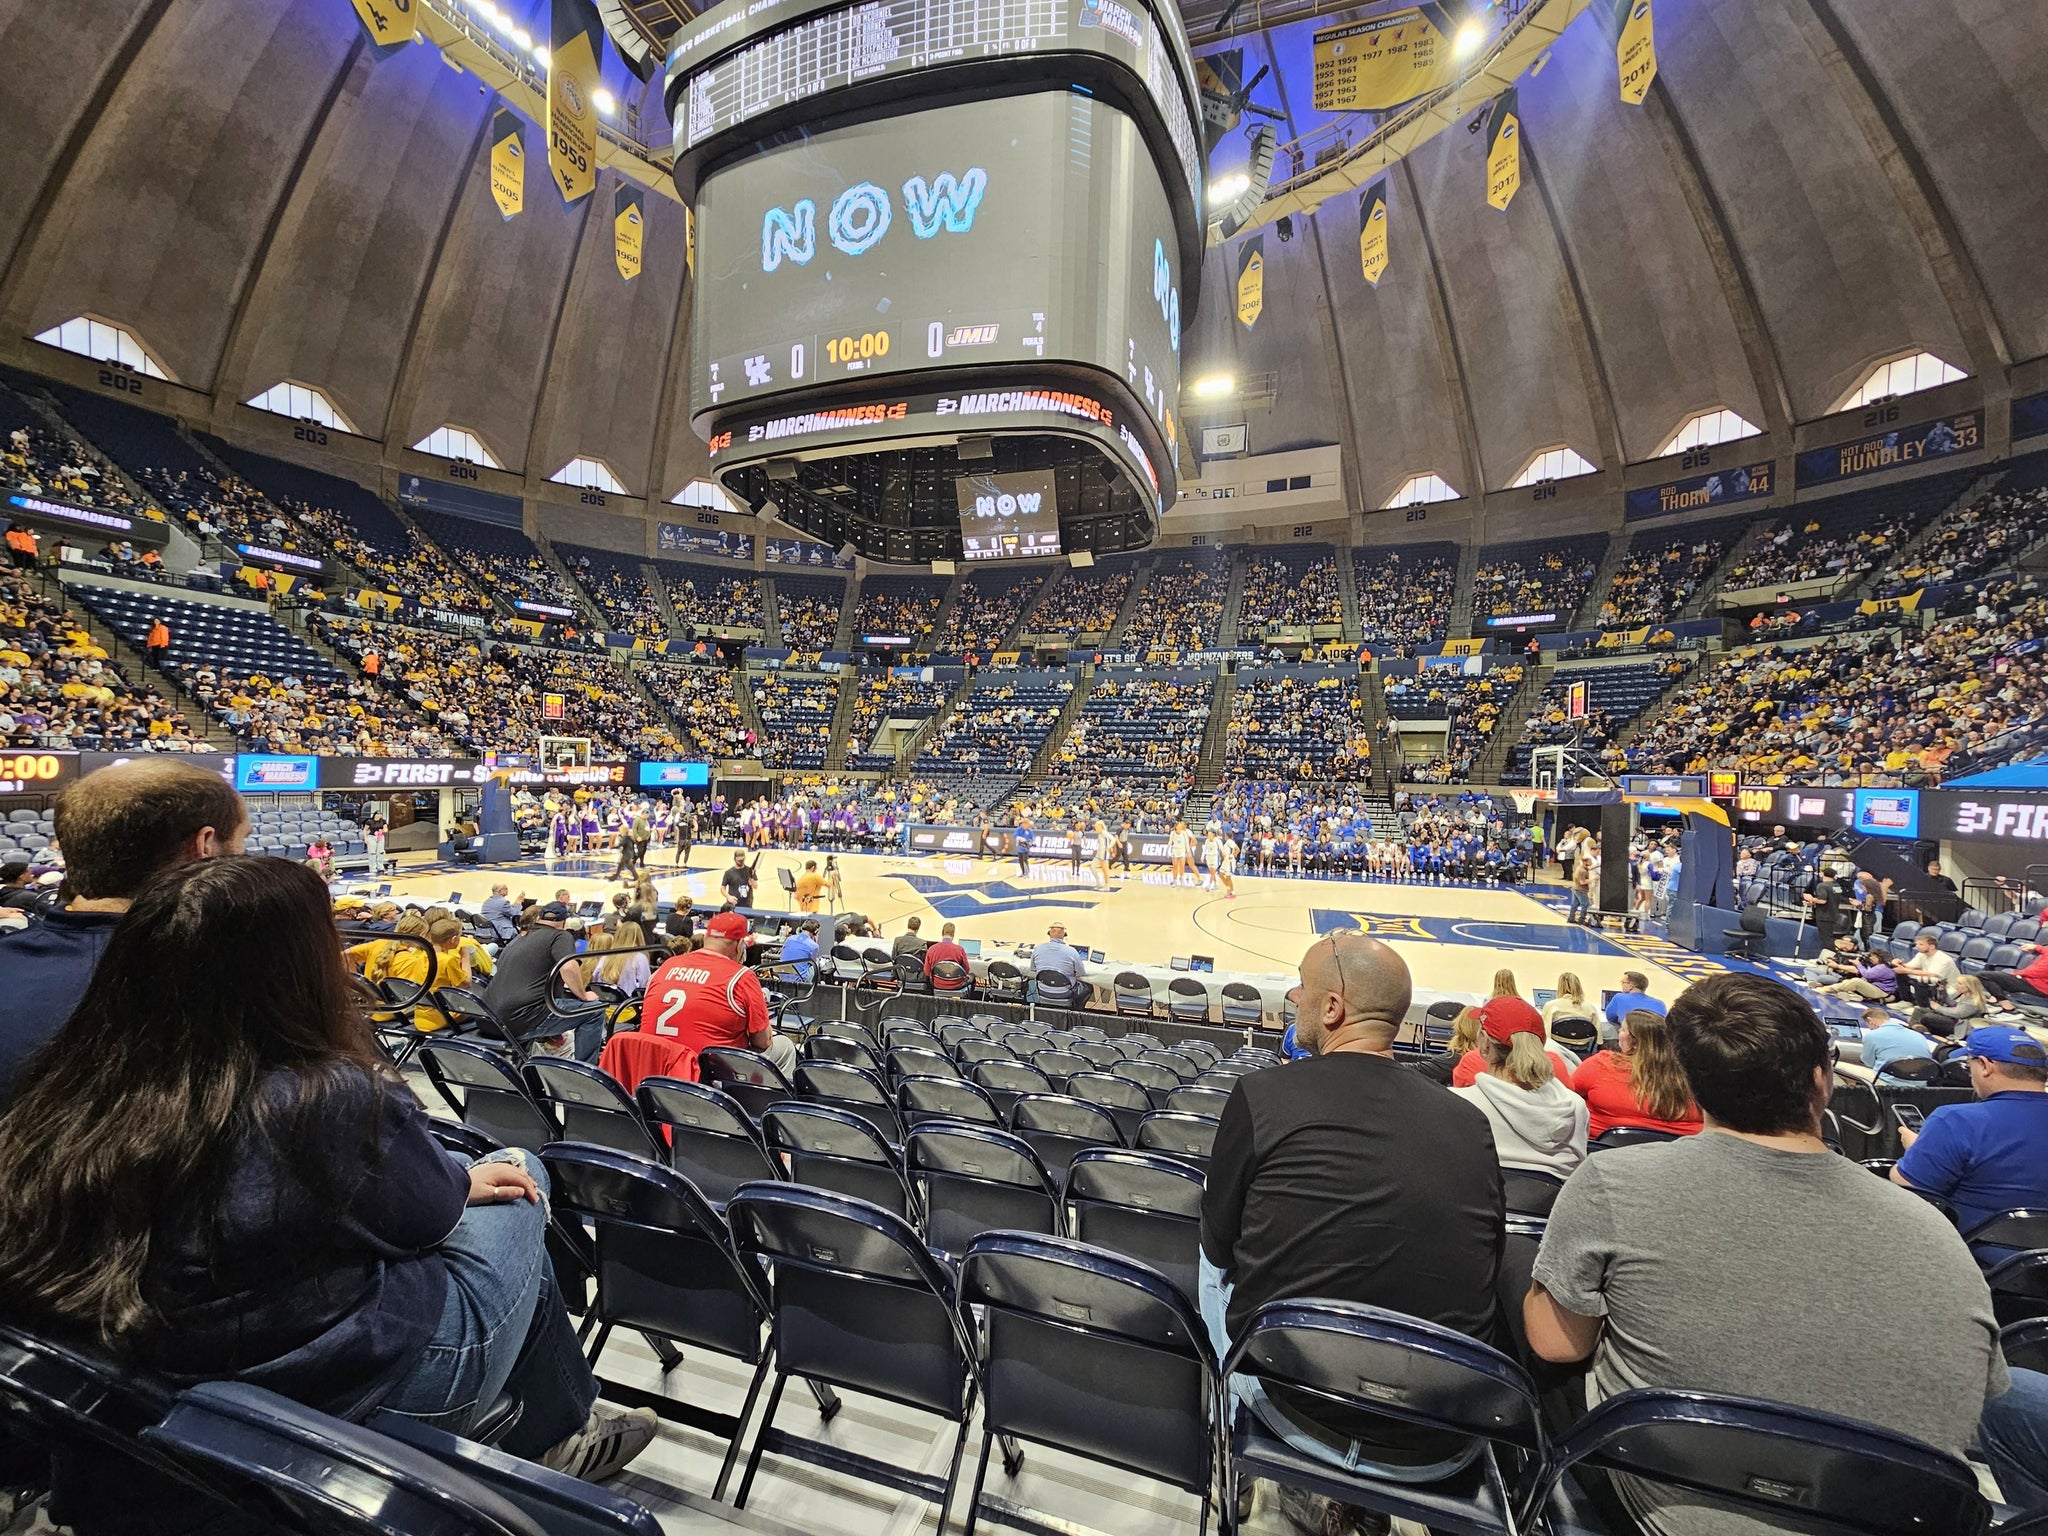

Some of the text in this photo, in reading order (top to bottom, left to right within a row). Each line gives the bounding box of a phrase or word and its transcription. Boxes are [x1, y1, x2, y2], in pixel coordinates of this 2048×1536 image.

[1097, 0, 1132, 23] MARCH
[1101, 12, 1142, 48] MADNESS
[1316, 13, 1421, 43] REGULAR SEASON CHAMPIONS
[1021, 39, 1029, 49] OF
[1316, 38, 1435, 70] 1952 1959 1977 1982 1983
[1315, 48, 1434, 80] 1955 1961 1985
[1315, 59, 1434, 90] 1956 1962 1989
[1314, 95, 1356, 109] 1958 1967
[1315, 86, 1357, 100] 1957 1963
[552, 131, 587, 173] 1959
[494, 179, 519, 202] 2005
[1492, 172, 1515, 195] 2017
[761, 167, 988, 273] NOW
[616, 249, 639, 265] 1960
[946, 324, 999, 346] JMU
[1036, 321, 1042, 333] 4
[826, 331, 890, 363] 10:00
[928, 321, 943, 358] 0
[1036, 345, 1043, 356] 0
[791, 343, 804, 379] 0
[100, 369, 143, 396] 202
[959, 391, 1101, 420] MARCHMADNESS
[1864, 406, 1900, 427] 216
[294, 427, 328, 446] 203
[1956, 427, 1978, 449] 33
[1840, 439, 1884, 458] HOT ROD
[1840, 440, 1926, 475] HUNDLEY
[1682, 451, 1710, 471] 215
[450, 465, 478, 481] 204
[1533, 485, 1556, 500] 214
[1660, 486, 1677, 498] ROD
[1748, 475, 1769, 494] 44
[581, 492, 605, 507] 205
[976, 492, 1041, 517] NOW
[1660, 489, 1711, 512] THORN
[697, 512, 719, 525] 206
[1406, 510, 1426, 522] 213
[1191, 535, 1206, 545] 211
[1293, 525, 1313, 537] 212
[1124, 653, 1136, 663] GO
[1187, 650, 1254, 662] MOUNTAINERS
[1455, 644, 1470, 655] 110
[384, 764, 453, 783] FIRST
[1715, 784, 1732, 794] 30
[1740, 790, 1773, 811] 10:00
[1042, 837, 1070, 848] FIRST
[665, 967, 710, 985] IPSARO
[656, 989, 687, 1037] 2
